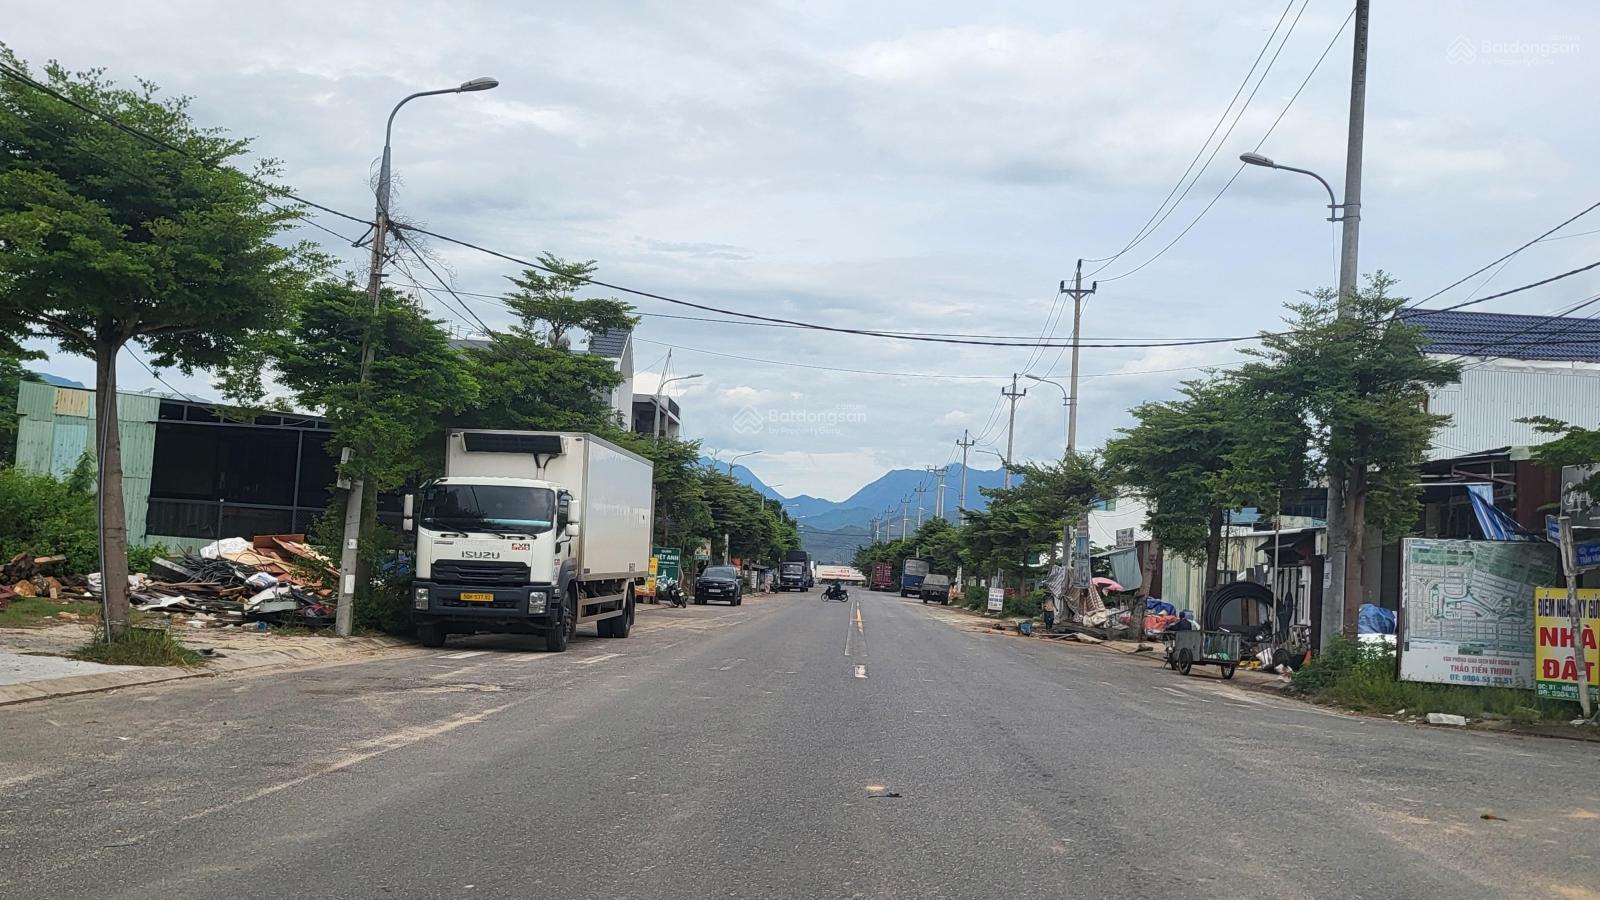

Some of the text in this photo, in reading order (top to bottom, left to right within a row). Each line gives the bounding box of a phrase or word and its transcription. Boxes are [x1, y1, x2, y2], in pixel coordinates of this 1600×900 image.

[461, 551, 500, 559] ISUZU
[1538, 591, 1555, 617] ĐIỂM
[1556, 597, 1571, 622] NHẬ
[1539, 624, 1597, 650] NHÀ
